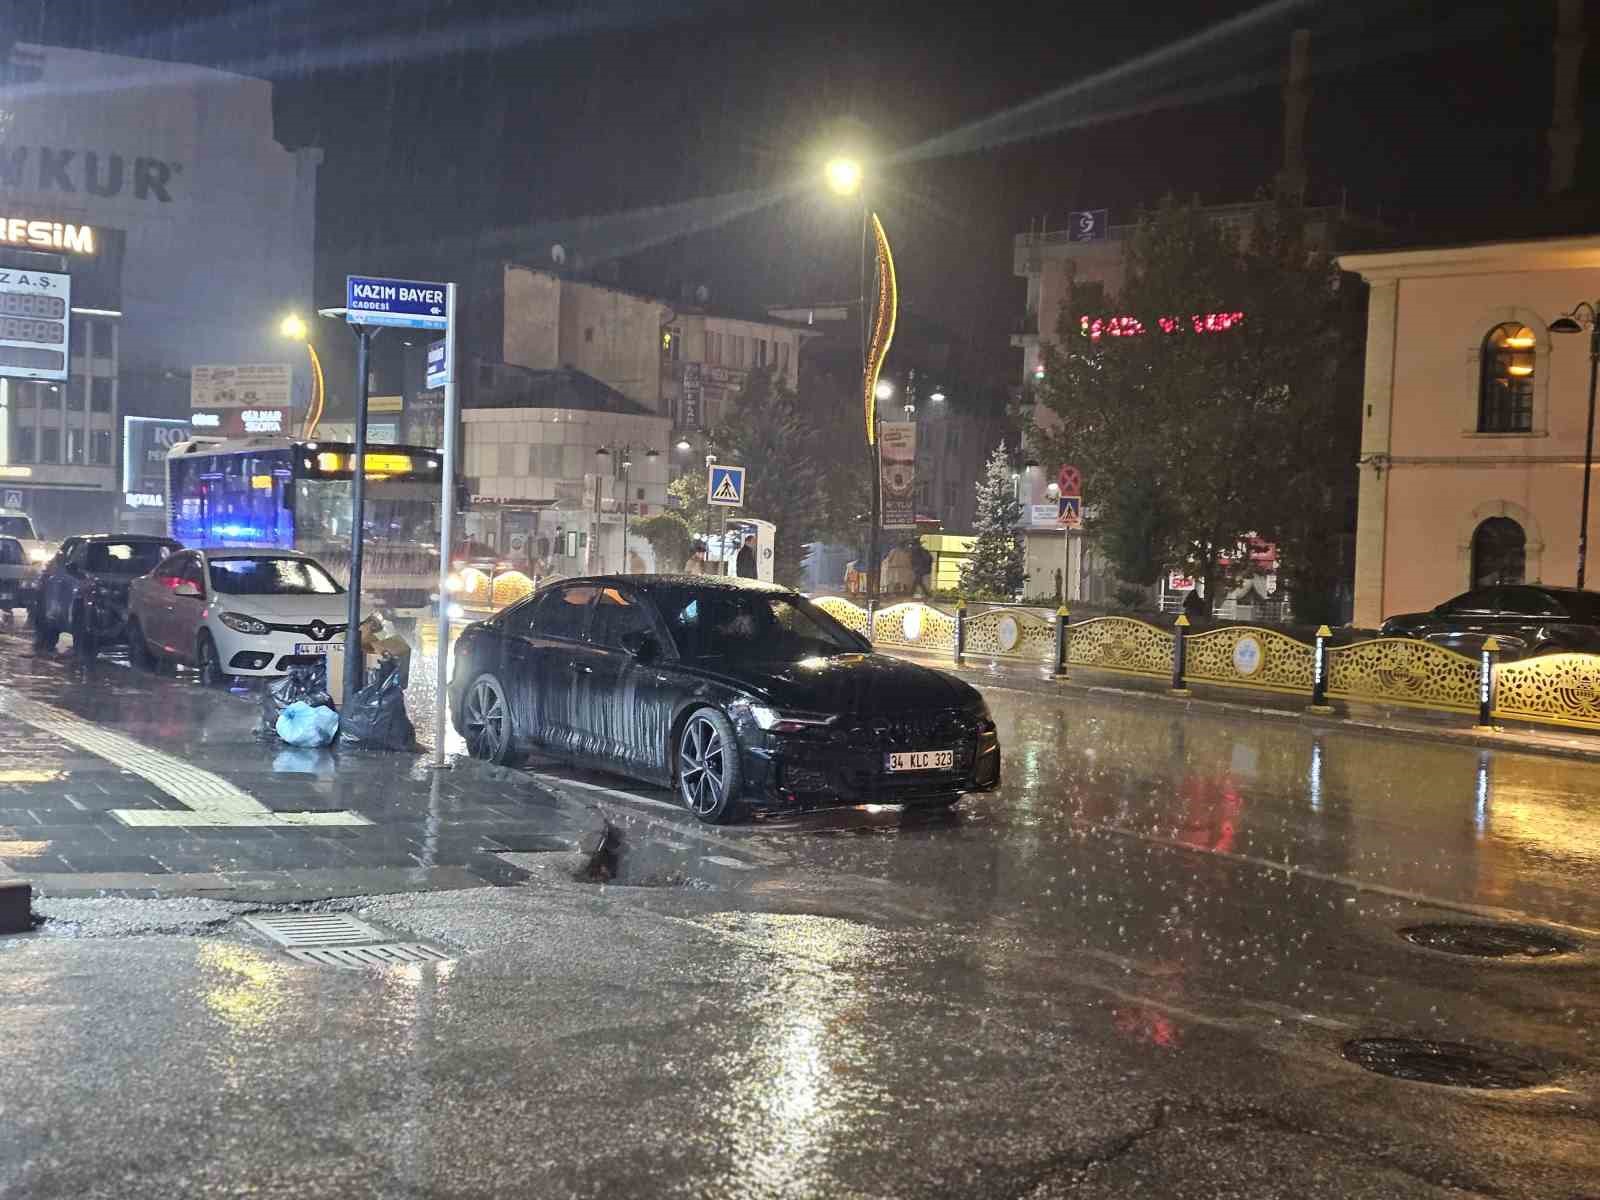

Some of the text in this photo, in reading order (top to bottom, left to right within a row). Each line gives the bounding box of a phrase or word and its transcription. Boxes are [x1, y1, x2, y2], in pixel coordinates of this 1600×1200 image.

[353, 284, 443, 304] KAZIM BAYER
[352, 300, 390, 311] CADDESİ
[890, 752, 953, 769] 34 KLC 323
